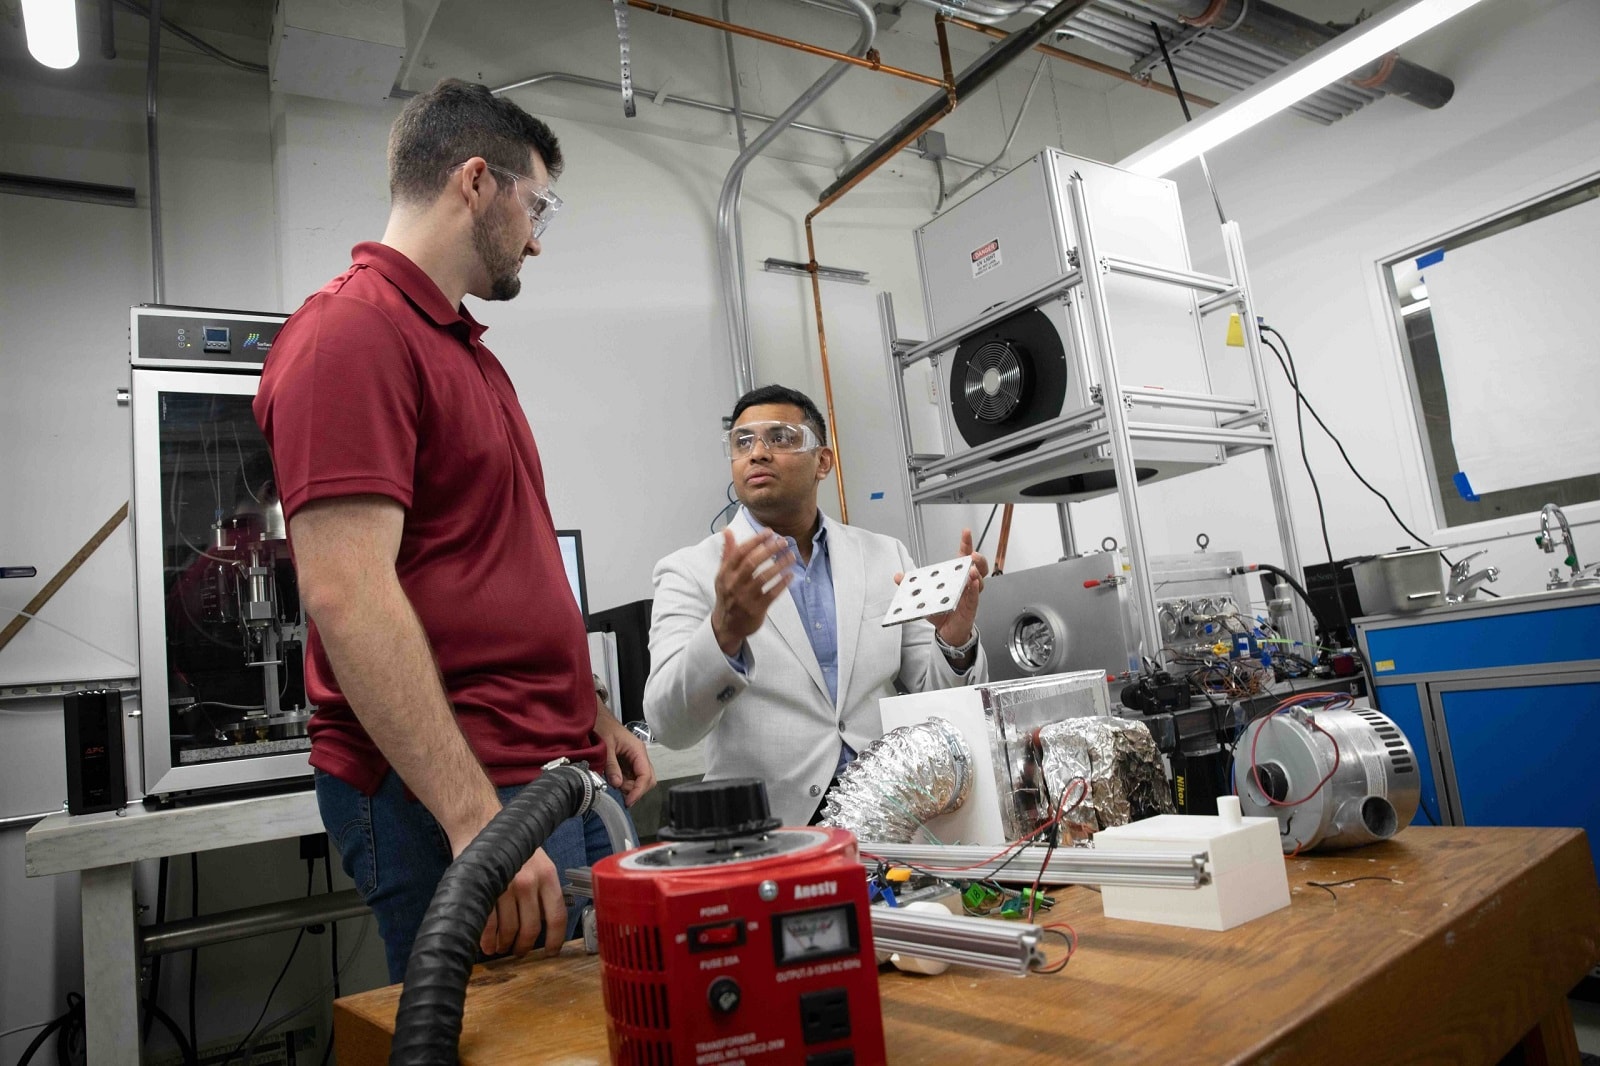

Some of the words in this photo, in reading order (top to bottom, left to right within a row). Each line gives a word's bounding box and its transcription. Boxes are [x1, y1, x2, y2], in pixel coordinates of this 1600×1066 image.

[974, 242, 997, 259] DANGER
[85, 746, 104, 754] APC
[1177, 775, 1185, 805] Nikon
[794, 881, 837, 899] Anesty
[700, 904, 729, 917] POWER
[700, 957, 722, 970] FUSE
[696, 1032, 757, 1053] TRANSFORMER
[696, 1051, 724, 1065] MODEL
